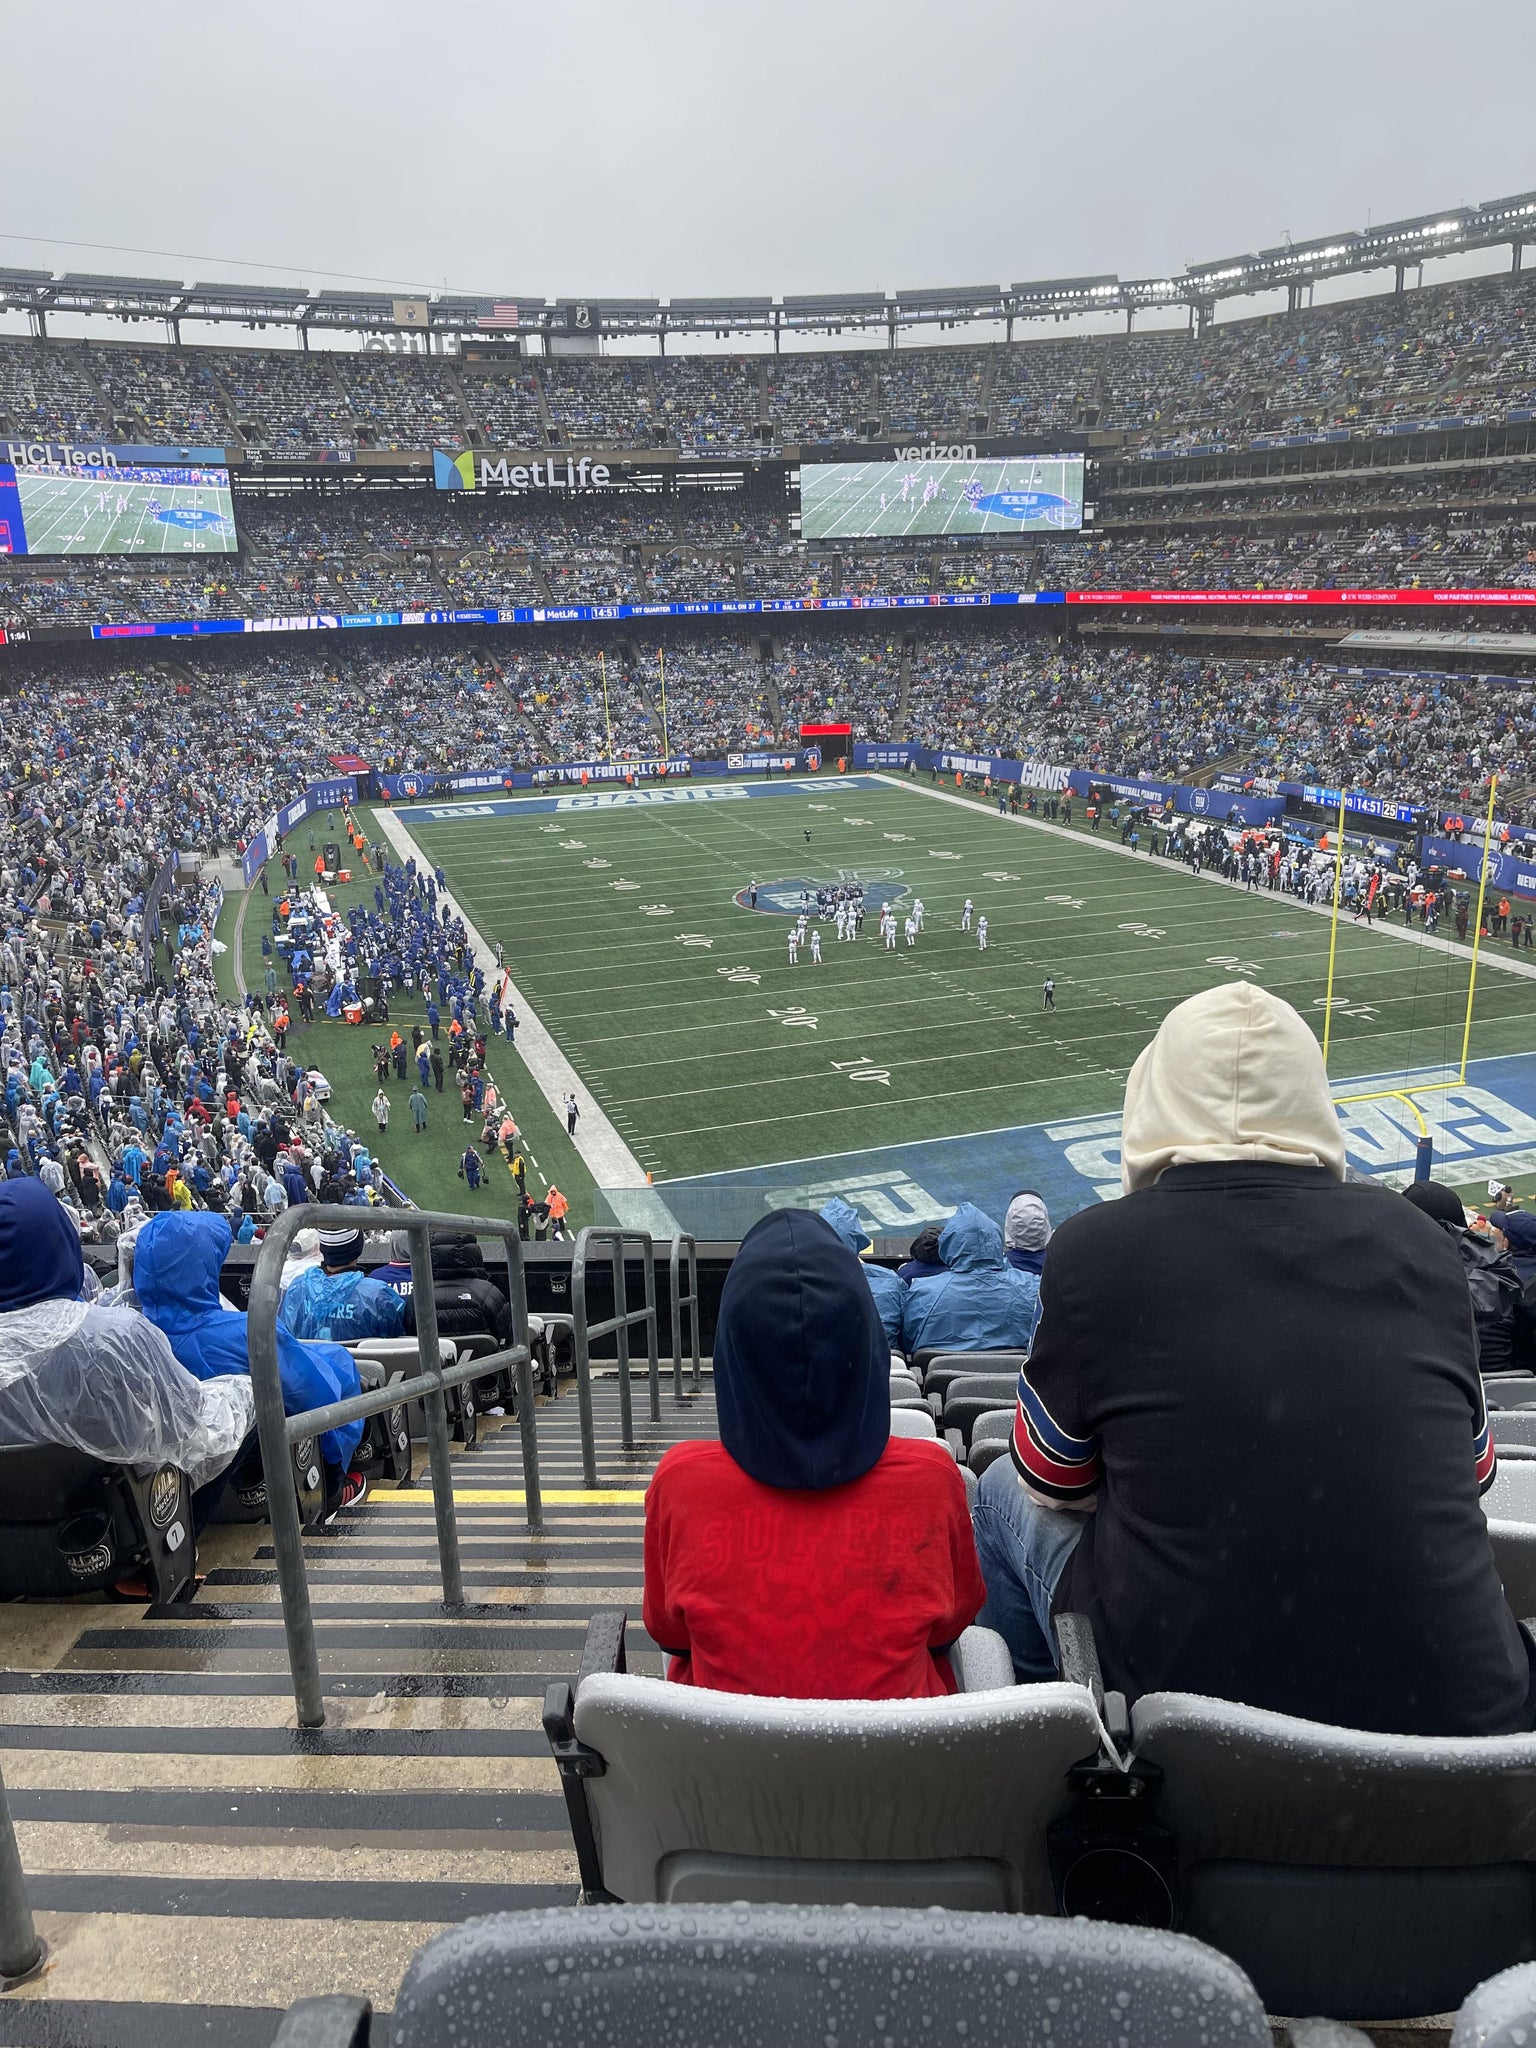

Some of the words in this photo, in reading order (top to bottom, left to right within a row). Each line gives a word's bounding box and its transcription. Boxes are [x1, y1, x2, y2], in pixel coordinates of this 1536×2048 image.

[7, 443, 118, 467] HCLTech
[893, 441, 976, 461] verizon
[480, 456, 610, 488] MetLife
[500, 612, 512, 621] 25
[546, 610, 579, 619] MetLife
[592, 608, 618, 618] 14:51
[642, 606, 671, 614] QUARTER
[375, 615, 382, 625] 0
[431, 613, 437, 623] 0
[9, 632, 26, 640] 1:04
[730, 756, 741, 766] 25
[1020, 762, 1071, 790] GIANTS
[1116, 784, 1141, 798] FOOTBALL
[556, 786, 750, 812] GIANTS
[1305, 795, 1317, 803] NYG
[1320, 797, 1325, 805] 0
[1357, 798, 1380, 813] 14:51
[1383, 803, 1396, 817] 25
[717, 965, 762, 982] 30
[766, 1006, 819, 1027] 20
[830, 1056, 891, 1082] 10
[400, 1436, 406, 1447] 5
[171, 1529, 178, 1544] 7
